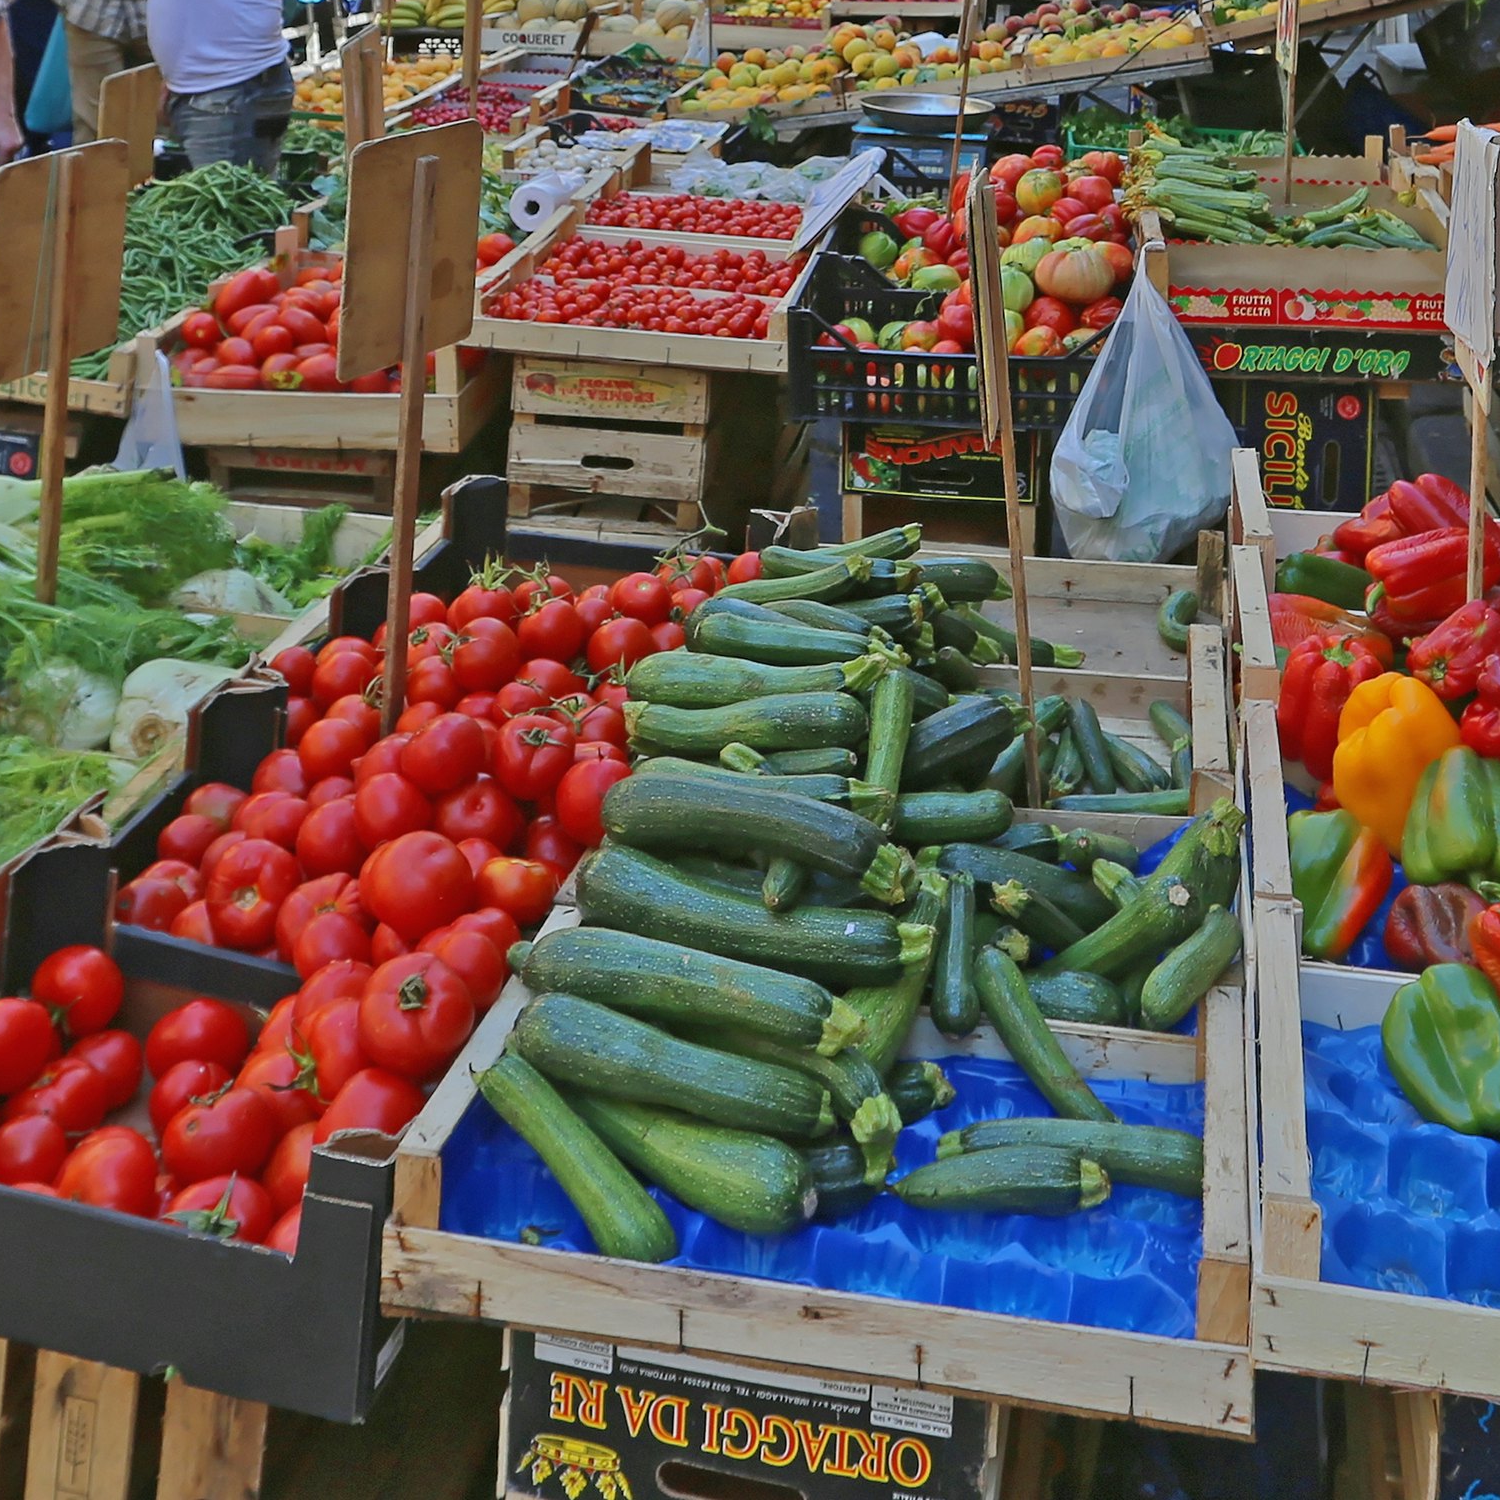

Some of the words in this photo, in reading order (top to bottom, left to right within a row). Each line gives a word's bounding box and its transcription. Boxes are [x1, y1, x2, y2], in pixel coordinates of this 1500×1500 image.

[502, 32, 566, 46] COQUERET
[1232, 295, 1273, 307] FRUTTA
[1416, 299, 1444, 311] FRUT
[1232, 306, 1272, 318] SCELTA
[1416, 310, 1444, 322] SCEL
[1332, 347, 1412, 378] D'ORO
[1263, 390, 1298, 506] SICILI
[639, 1366, 677, 1383] VITTORIA
[550, 1371, 607, 1431] RE
[757, 1389, 810, 1407] IMBALLAGGI
[615, 1386, 690, 1448] DA
[700, 1402, 932, 1489] ORTAGGI
